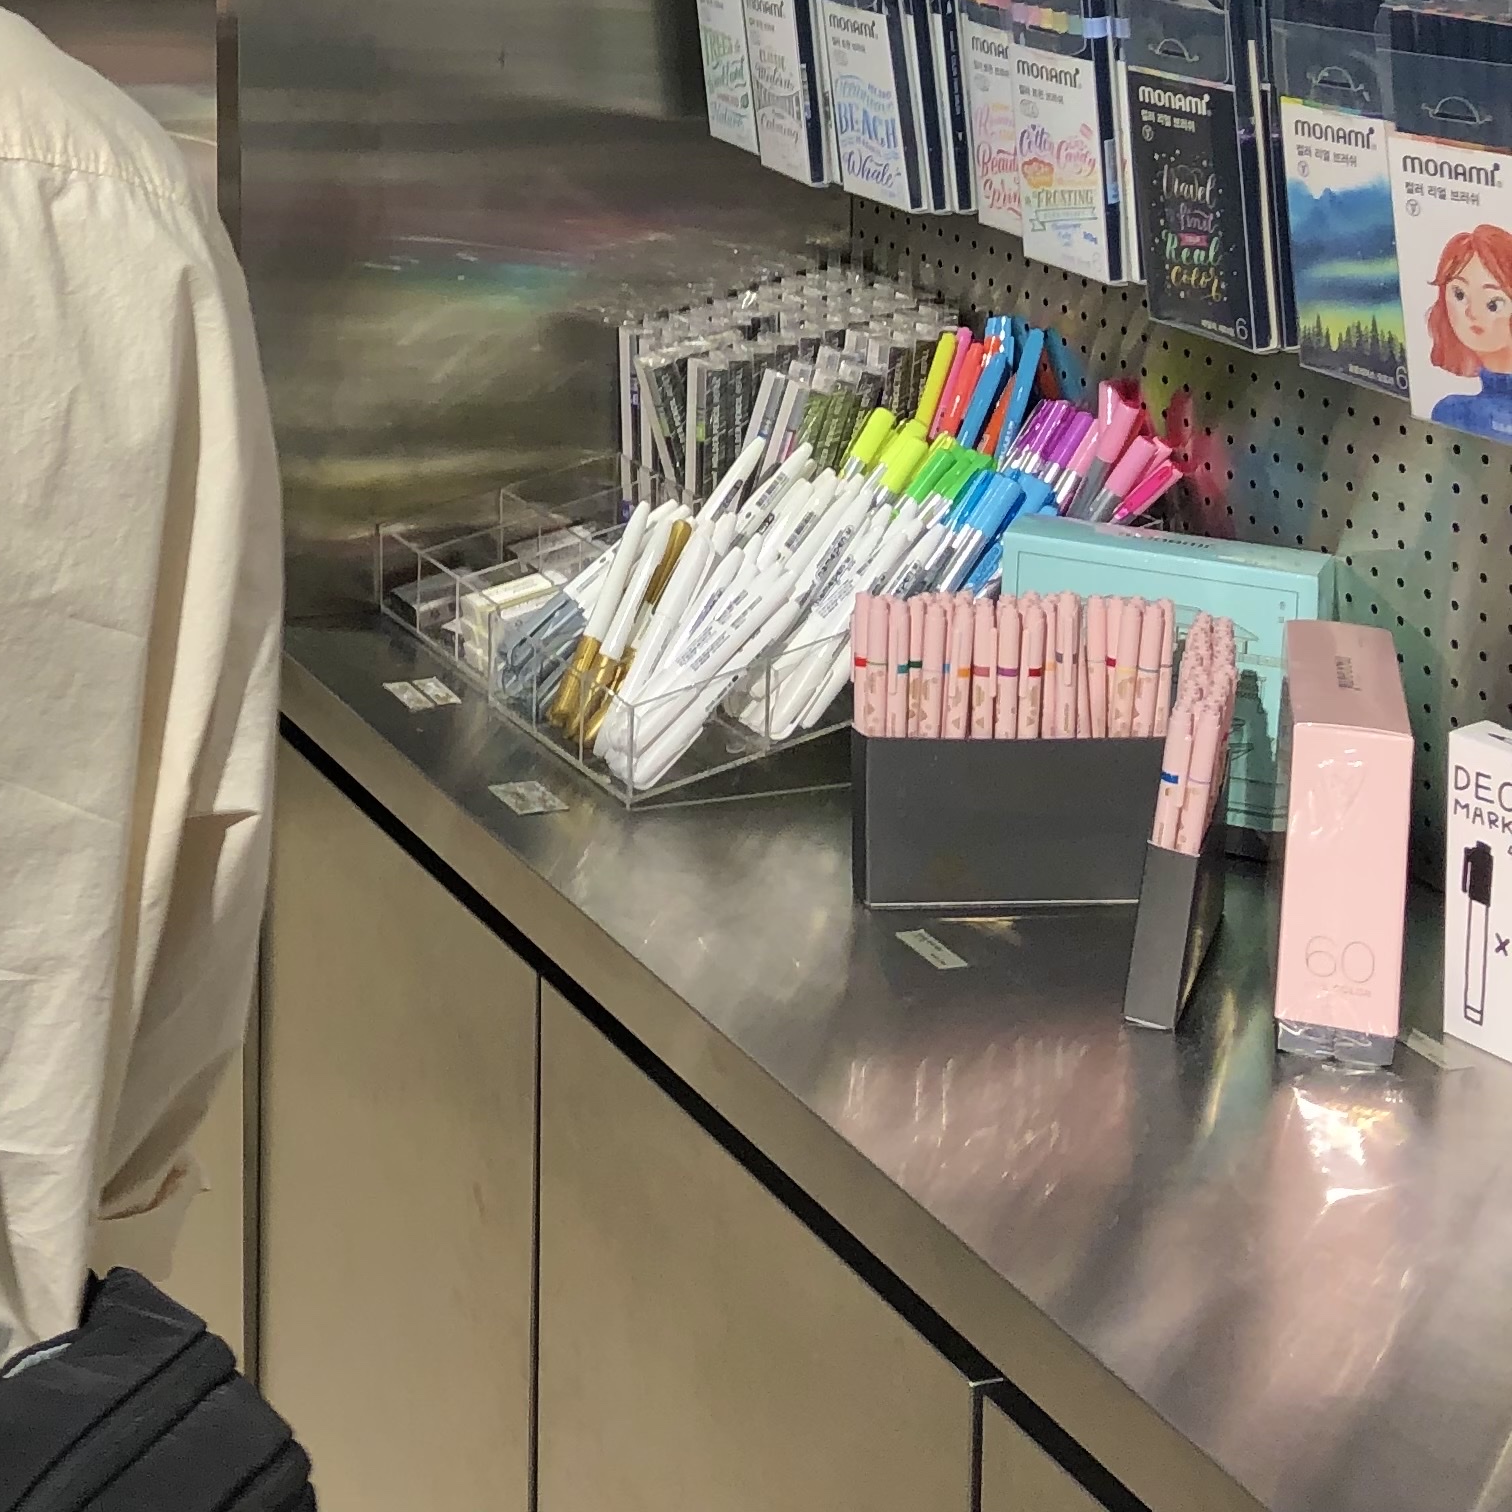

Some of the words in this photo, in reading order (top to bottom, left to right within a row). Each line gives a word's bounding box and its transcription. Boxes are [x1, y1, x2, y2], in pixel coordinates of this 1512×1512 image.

[837, 101, 898, 149] BEACH
[845, 149, 898, 188] Whale
[976, 141, 1019, 179] Beaut
[1056, 140, 1096, 177] Candy
[983, 178, 1021, 209] Sprin
[1036, 189, 1094, 208] FROSTING
[1162, 229, 1223, 266] Real
[1235, 317, 1249, 341] 6
[1395, 365, 1408, 390] 6
[1305, 935, 1375, 984] 60
